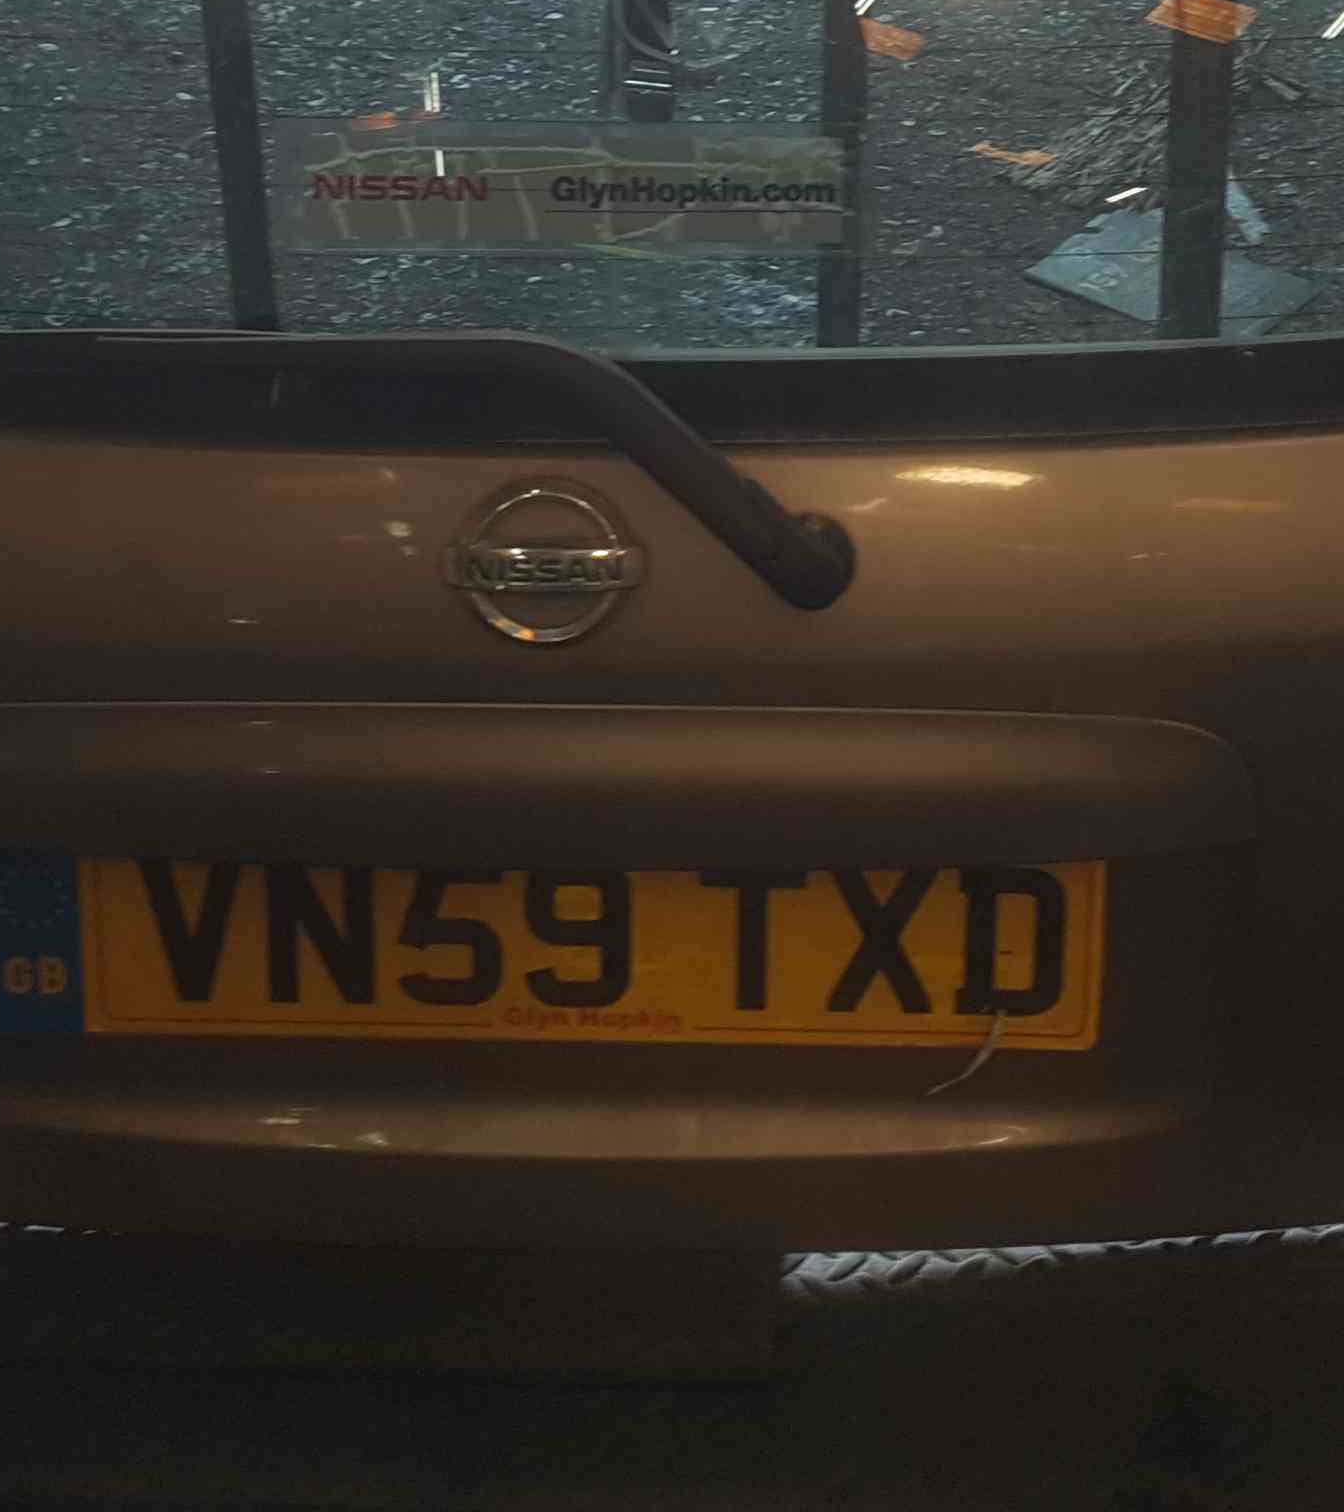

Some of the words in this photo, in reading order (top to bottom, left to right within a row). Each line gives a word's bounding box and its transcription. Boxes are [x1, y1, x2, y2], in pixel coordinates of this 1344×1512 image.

[312, 174, 489, 202] NISSAN
[550, 174, 835, 207] GlynHopkin.com
[471, 552, 626, 587] NISSAN
[134, 857, 634, 1011] VN59
[697, 862, 1068, 1018] TXD
[3, 956, 68, 994] GB
[502, 1005, 569, 1032] Glyn
[581, 1007, 682, 1033] Hopkin
